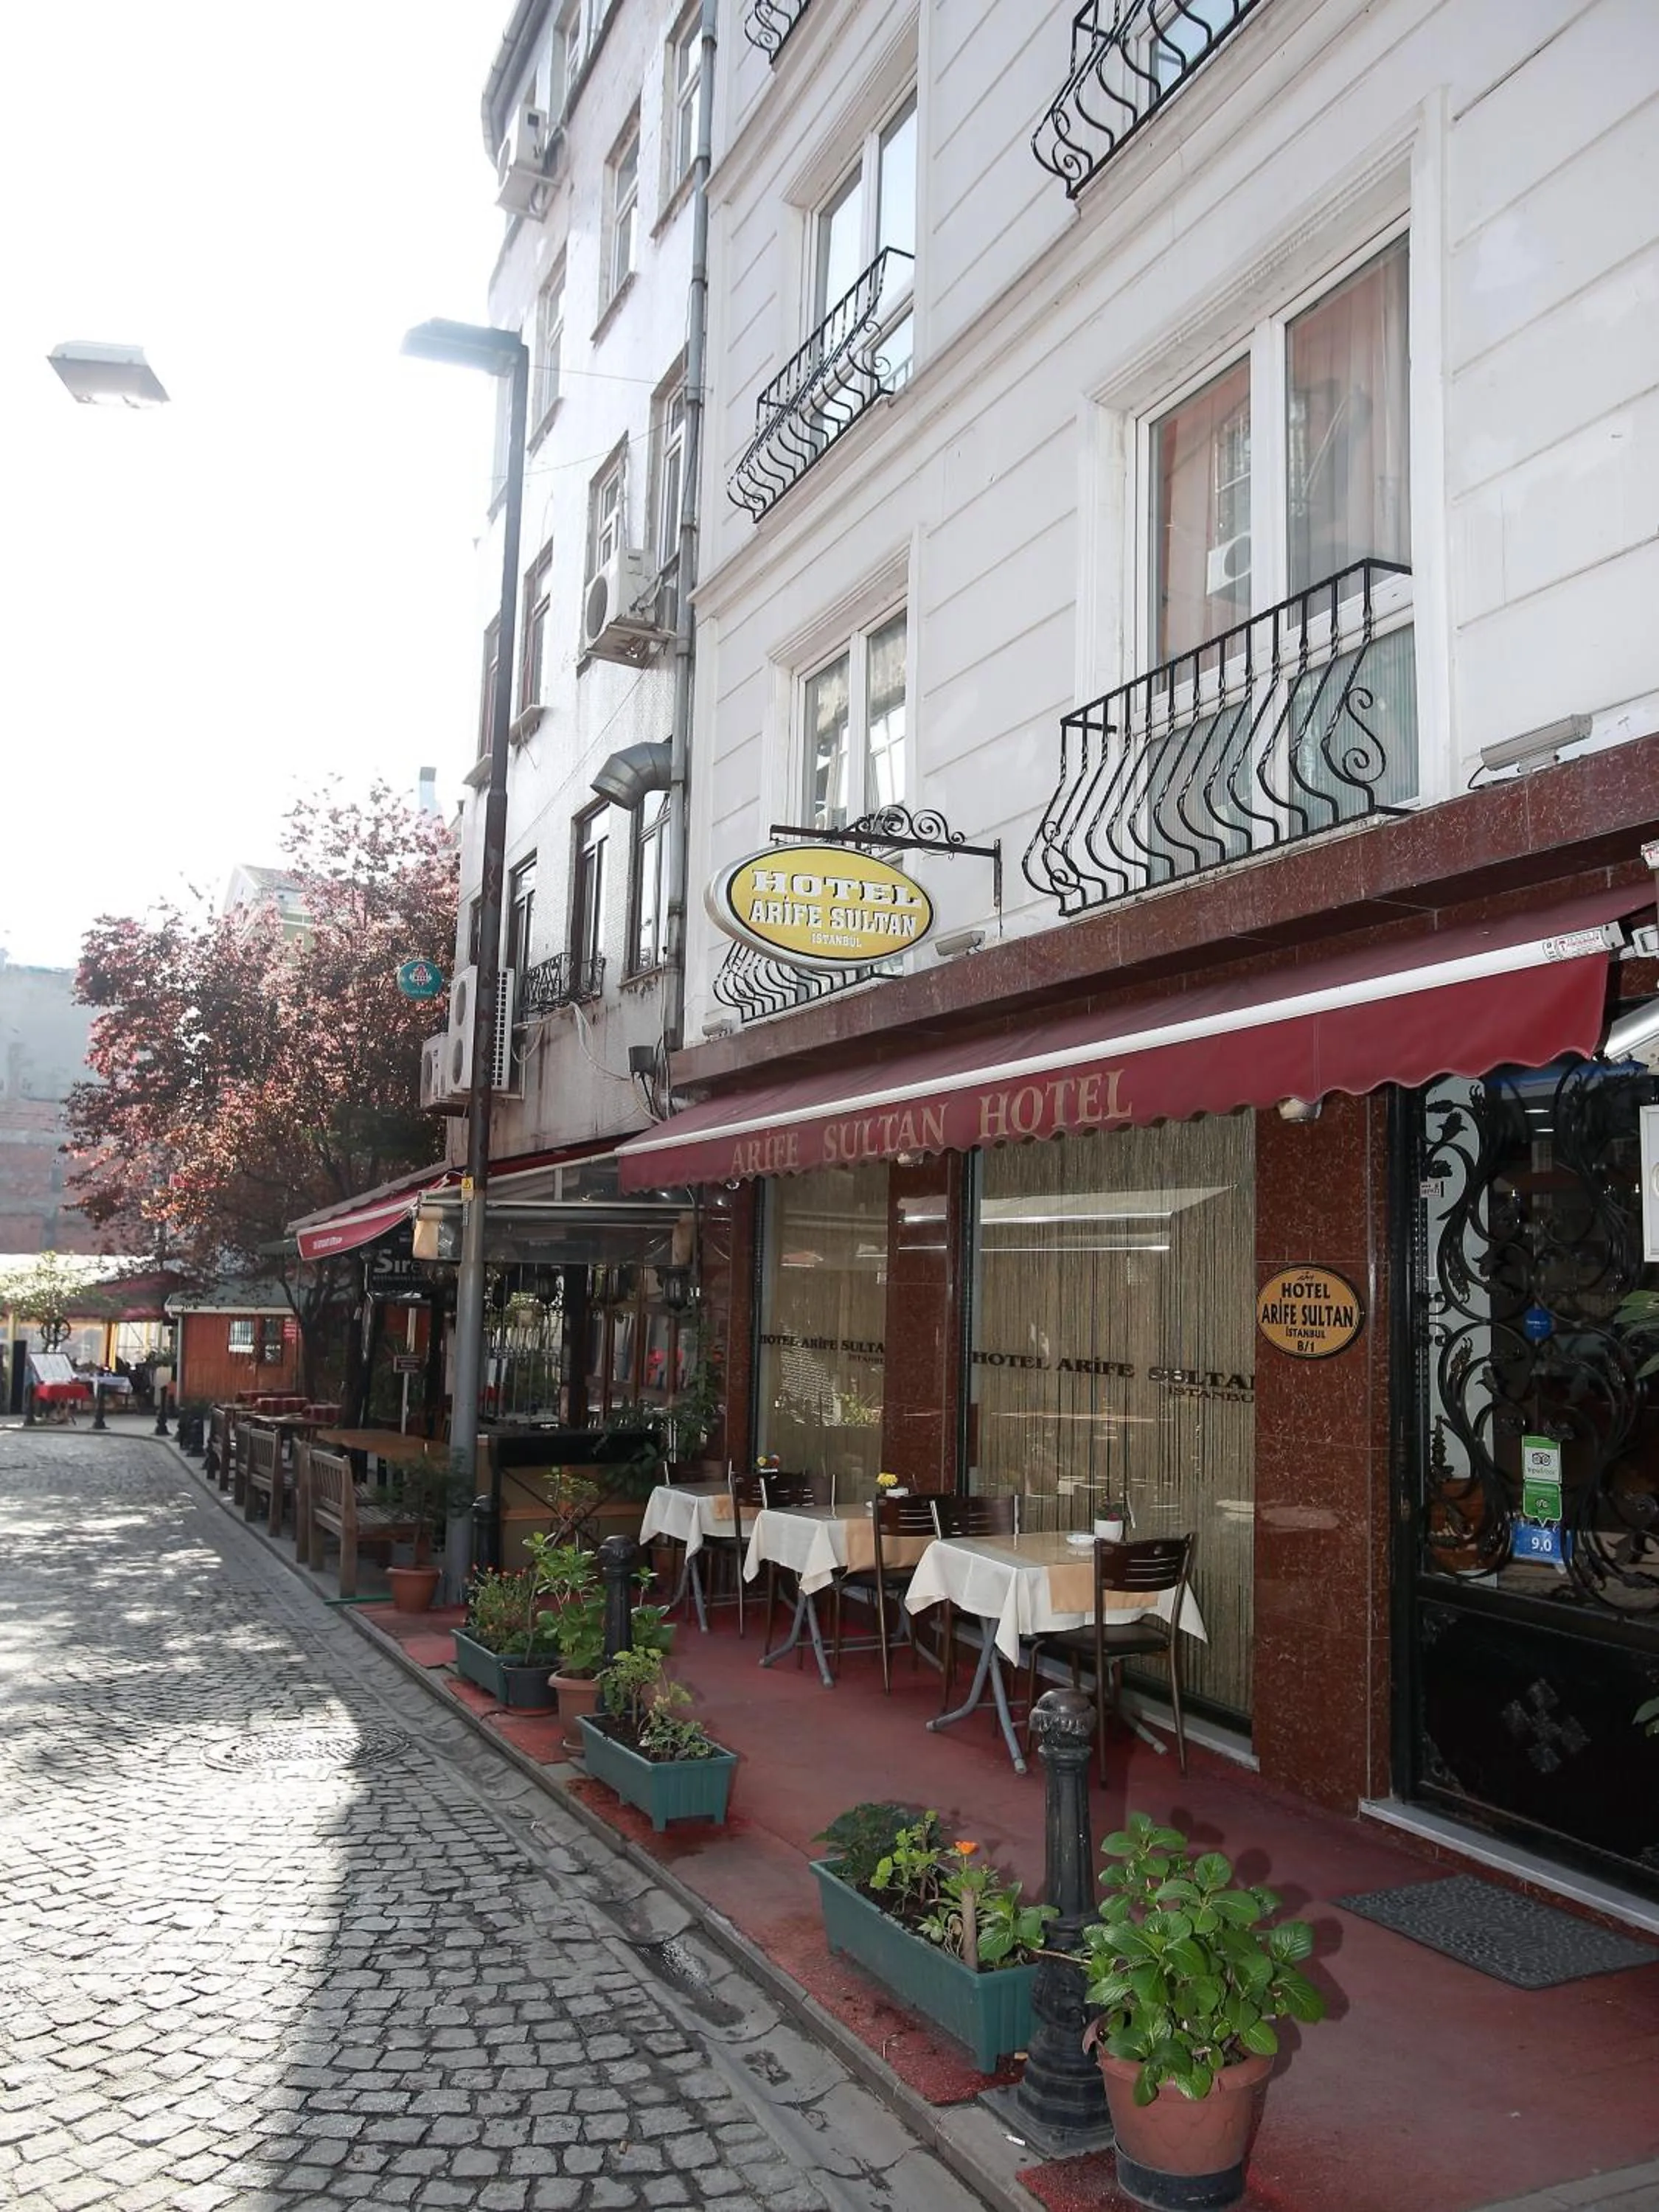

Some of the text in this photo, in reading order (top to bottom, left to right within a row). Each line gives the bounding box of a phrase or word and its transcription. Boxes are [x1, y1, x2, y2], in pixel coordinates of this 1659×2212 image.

[751, 869, 922, 908] HOTEL
[749, 895, 917, 938] ARİFE SULTAN
[822, 1104, 950, 1162] SULTAN
[978, 1068, 1133, 1139] HOTEL
[1281, 1282, 1331, 1298] HOTEL
[1261, 1298, 1354, 1328] ARİFE SULTAN
[971, 1351, 1050, 1371] HOTEL
[1057, 1357, 1135, 1378] ARİFE
[1531, 1537, 1552, 1553] 9.0
